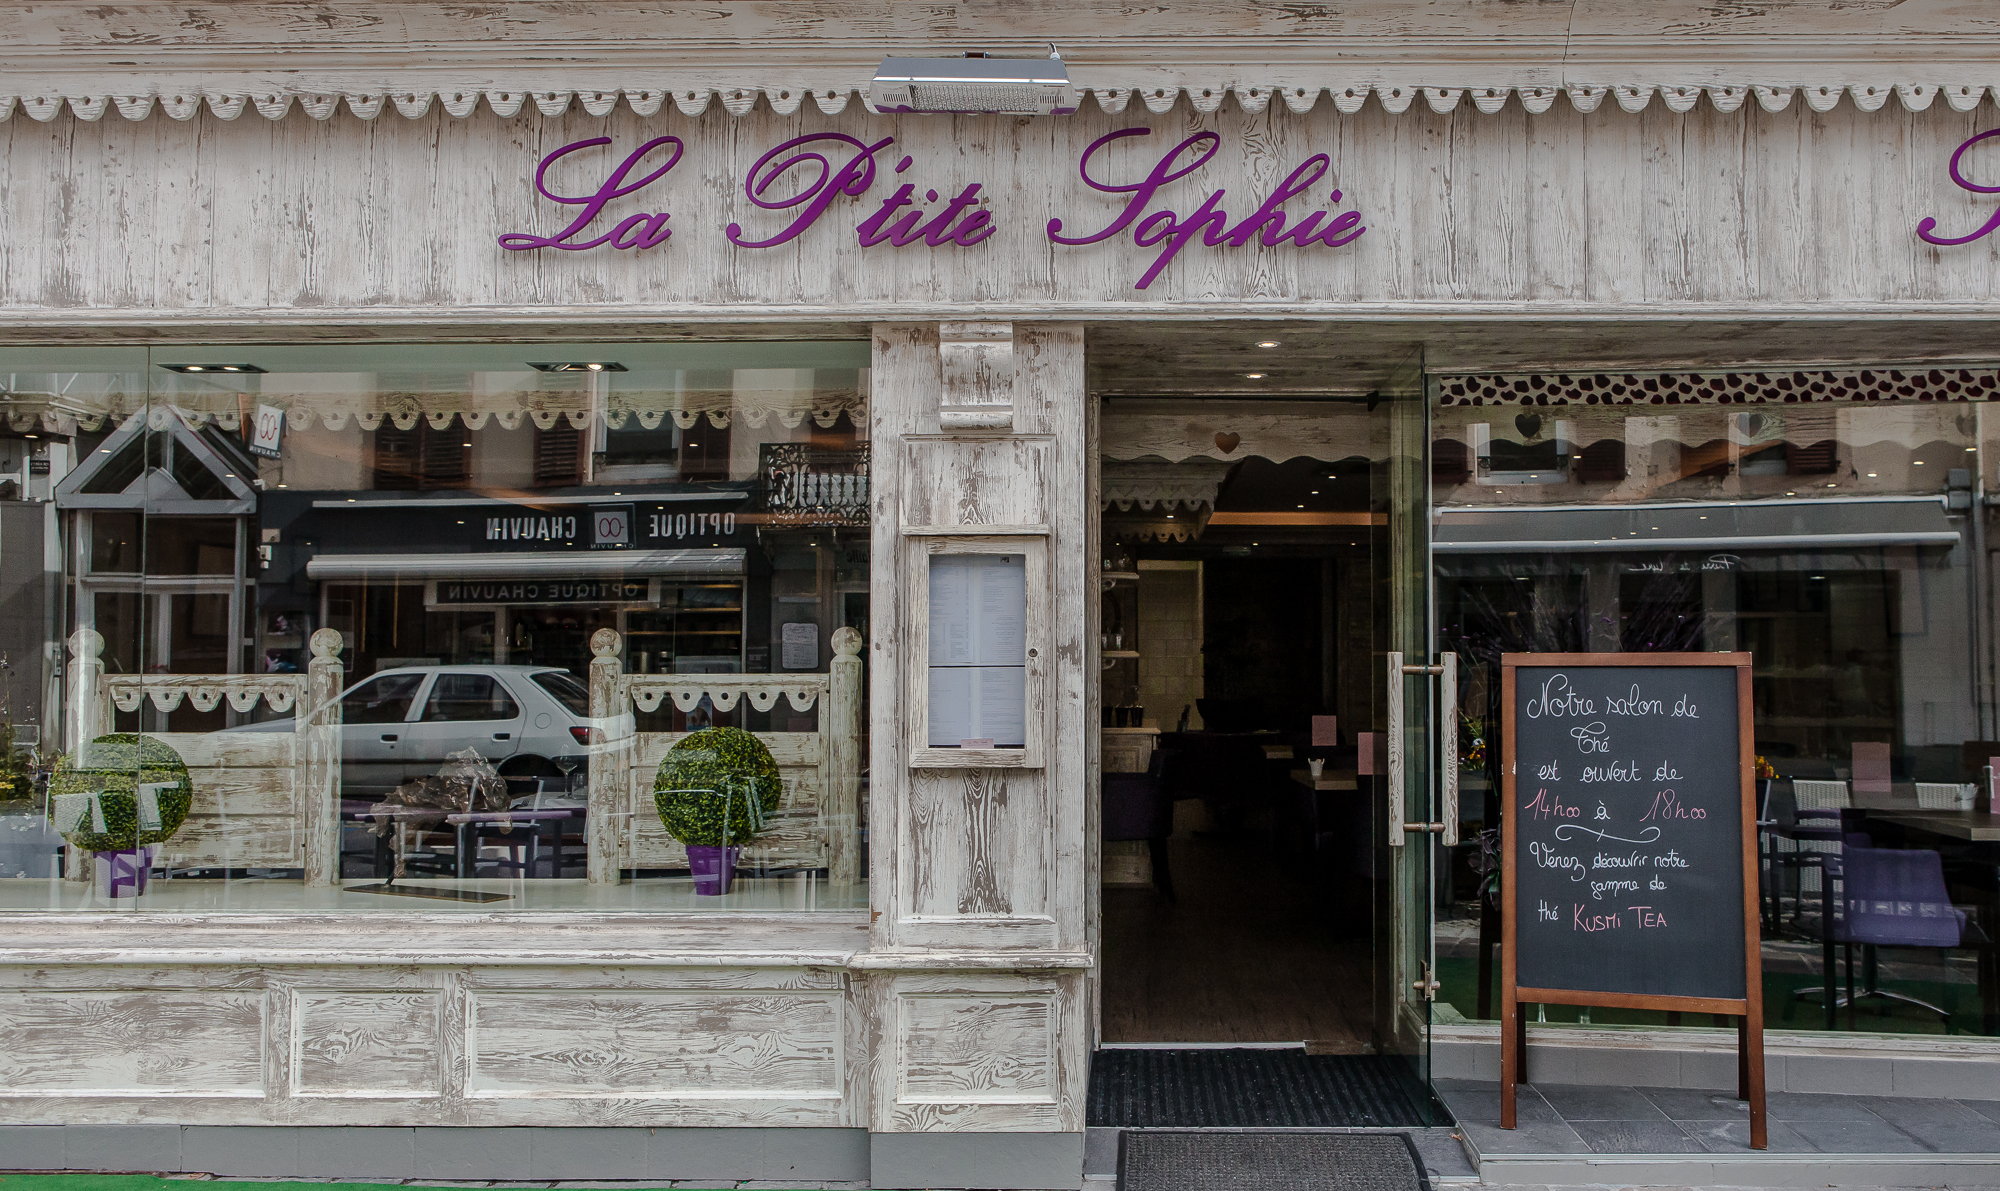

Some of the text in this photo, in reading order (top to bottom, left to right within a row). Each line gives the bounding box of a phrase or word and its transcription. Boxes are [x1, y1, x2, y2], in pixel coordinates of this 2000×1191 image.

[498, 127, 1367, 290] La P'tite Sophie
[1527, 674, 1700, 718] Notre salon de
[1570, 721, 1610, 754] Thé
[1537, 760, 1683, 782] est ouvert de
[1593, 800, 1610, 820] à
[1529, 841, 1690, 882] Venez découvrir notre
[1590, 874, 1667, 900] gamme de
[1538, 900, 1559, 922] thé
[1628, 906, 1668, 928] TEA
